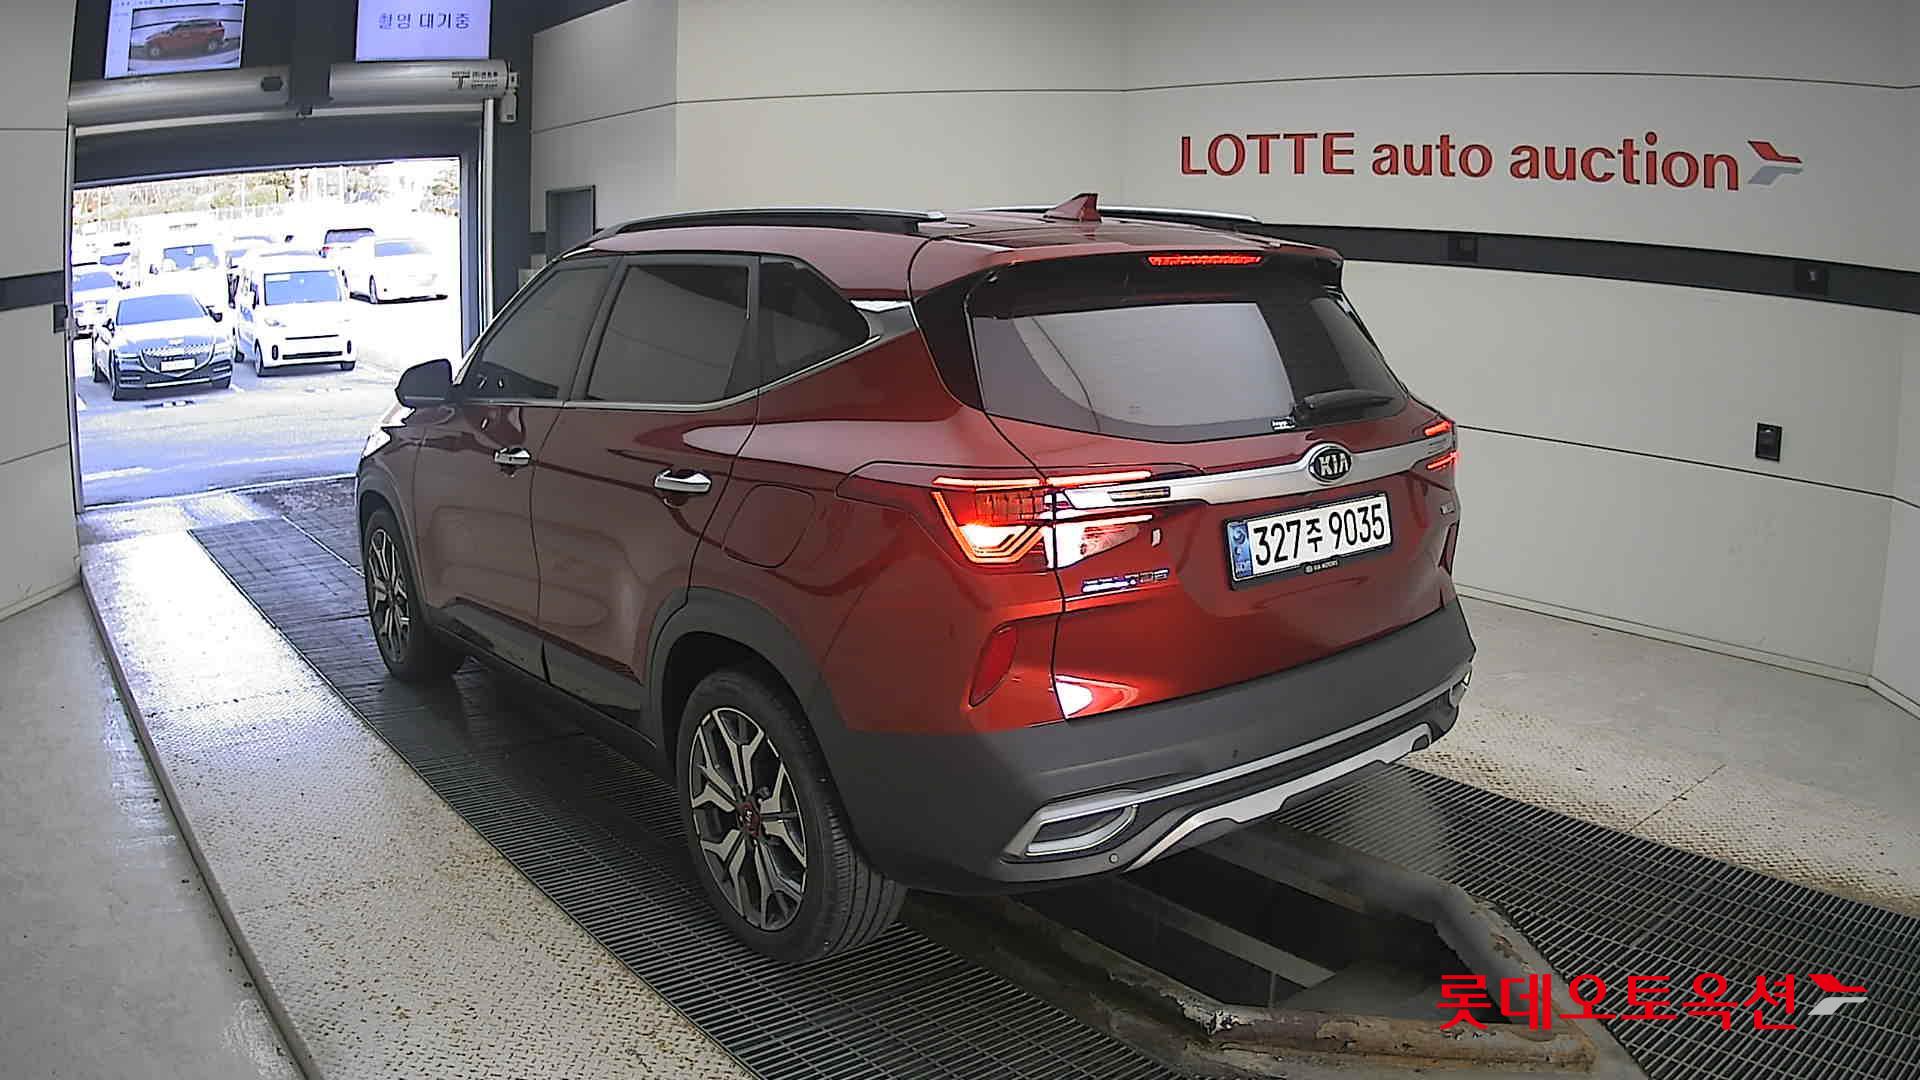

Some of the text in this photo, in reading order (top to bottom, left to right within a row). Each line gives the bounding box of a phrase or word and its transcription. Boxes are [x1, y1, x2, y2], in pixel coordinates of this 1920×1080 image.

[1181, 132, 1739, 191] LOTTE auto auction
[1319, 453, 1349, 477] KIA
[1253, 504, 1385, 565] 327주 9035
